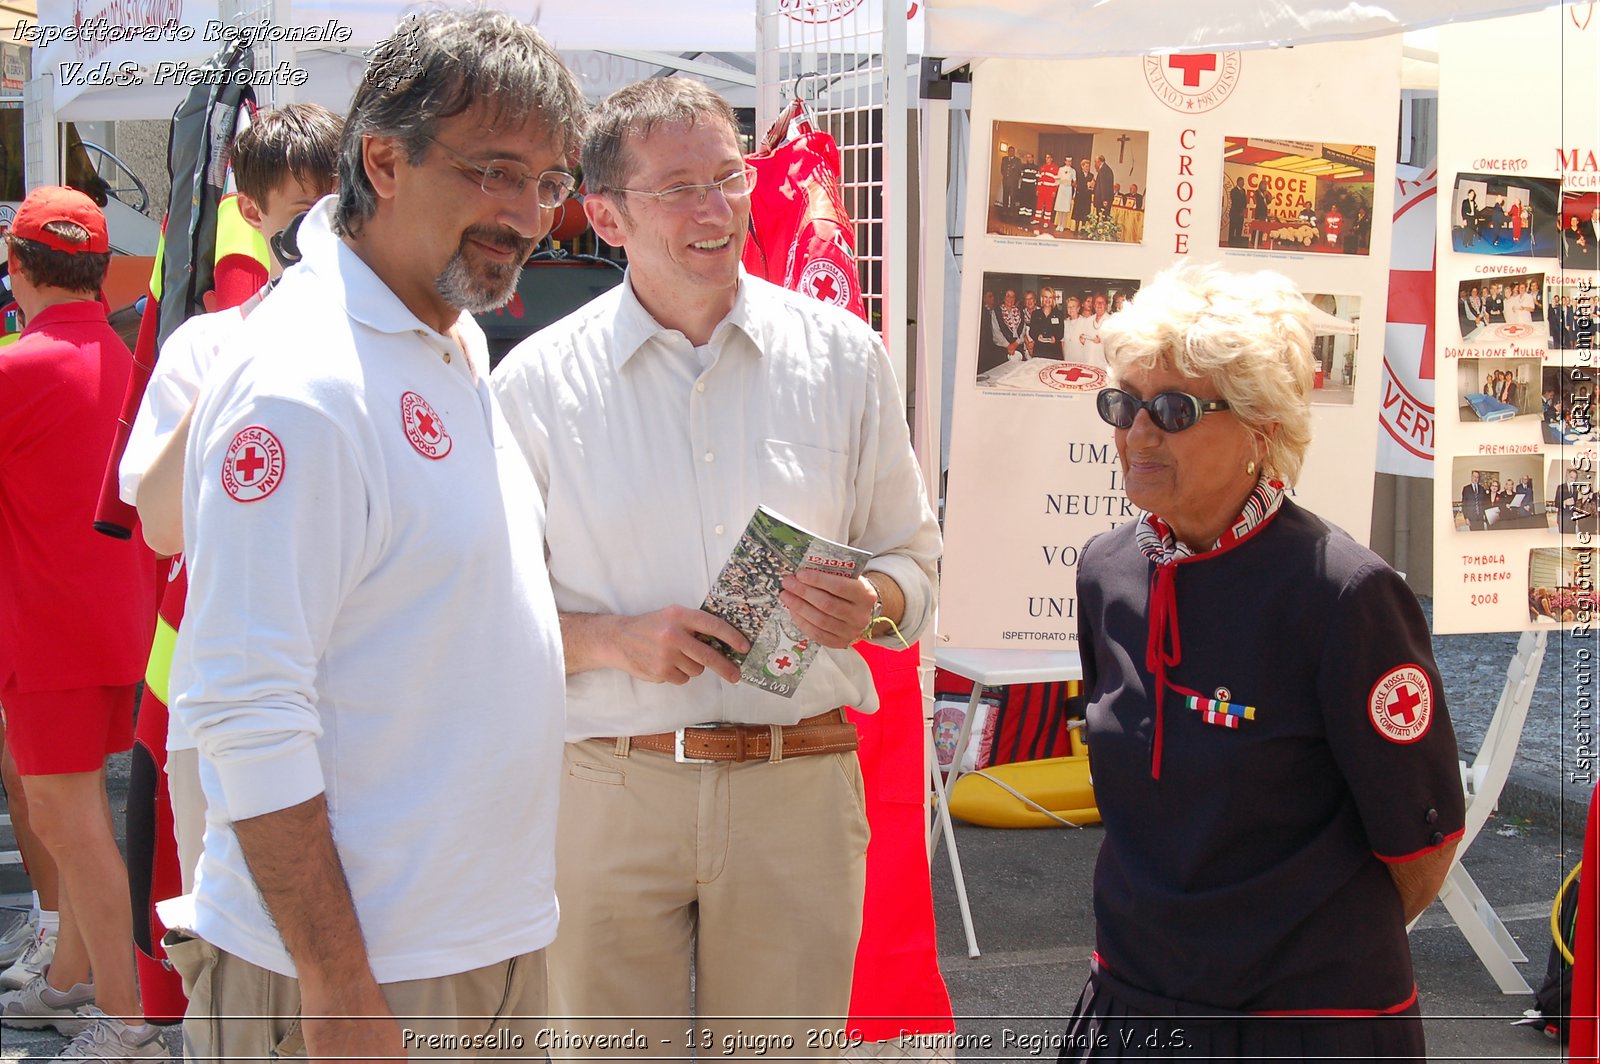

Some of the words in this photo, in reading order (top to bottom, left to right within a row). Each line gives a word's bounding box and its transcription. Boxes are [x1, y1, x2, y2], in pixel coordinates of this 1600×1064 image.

[1473, 159, 1528, 172] CONCERTO
[1247, 173, 1307, 193] CROCE
[1246, 189, 1307, 208] RSSA
[1475, 265, 1528, 274] CONVEGNO
[1445, 347, 1507, 358] DONAZIONE
[231, 430, 262, 453] ROSSA
[1479, 444, 1539, 454] PREMIAZIONE
[257, 437, 280, 493] ITALIANA
[225, 457, 239, 495] CROCE
[1045, 494, 1142, 517] NEUTR
[1462, 555, 1505, 565] TOMBOLA
[1463, 572, 1511, 583] PREMENO
[1471, 593, 1499, 606] 2008
[1002, 631, 1067, 641] ISPETTORATO
[769, 681, 790, 695] (VB)
[1375, 691, 1386, 714] CROCE
[1383, 673, 1406, 690] ROSSA
[1407, 672, 1427, 694] ITALIANA
[1380, 717, 1411, 736] COMITATO
[1412, 698, 1429, 734] FEMMINILE
